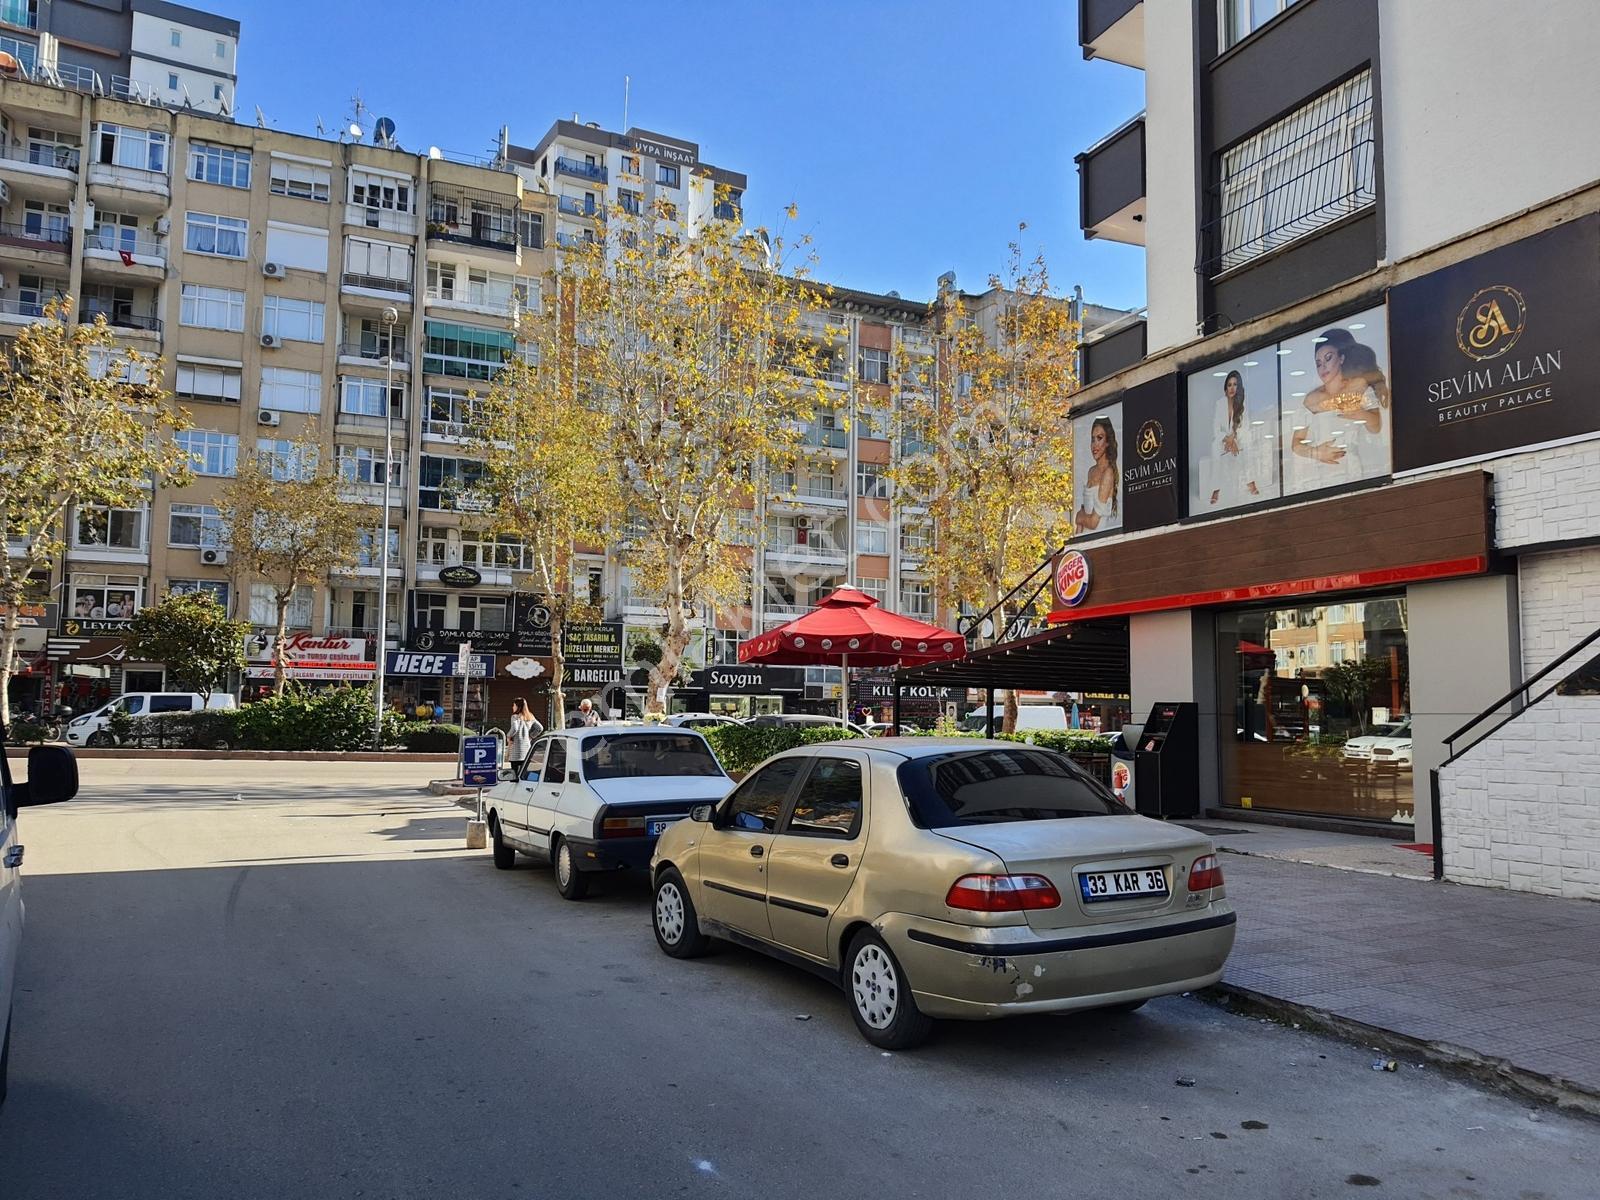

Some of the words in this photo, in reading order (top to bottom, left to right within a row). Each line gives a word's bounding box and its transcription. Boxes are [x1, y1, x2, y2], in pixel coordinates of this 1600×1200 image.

[663, 147, 695, 164] İNŞAAT
[1428, 368, 1493, 403] SEVİM
[1501, 350, 1562, 385] ALAN
[1438, 402, 1488, 422] BEAUTY
[1499, 387, 1552, 407] PALACE
[1124, 464, 1150, 481] SEVİM
[1152, 457, 1177, 475] ALAN
[1128, 482, 1148, 492] BEAUTY
[1152, 476, 1173, 486] PALACE
[1059, 565, 1085, 596] KING
[82, 621, 123, 630] LEYLA
[283, 632, 350, 651] Kantur
[569, 633, 582, 643] SAÇ
[583, 634, 610, 642] TASARIM
[564, 642, 593, 653] GÜZELLİK
[594, 643, 620, 654] MERKEZİ
[394, 655, 447, 674] HECE
[574, 668, 620, 682] BARGELLO
[710, 670, 763, 688] Saygın
[872, 685, 906, 696] KILF
[474, 749, 487, 763] P
[1088, 874, 1107, 894] 33
[1114, 872, 1141, 892] KAR
[1145, 871, 1164, 889] 36
